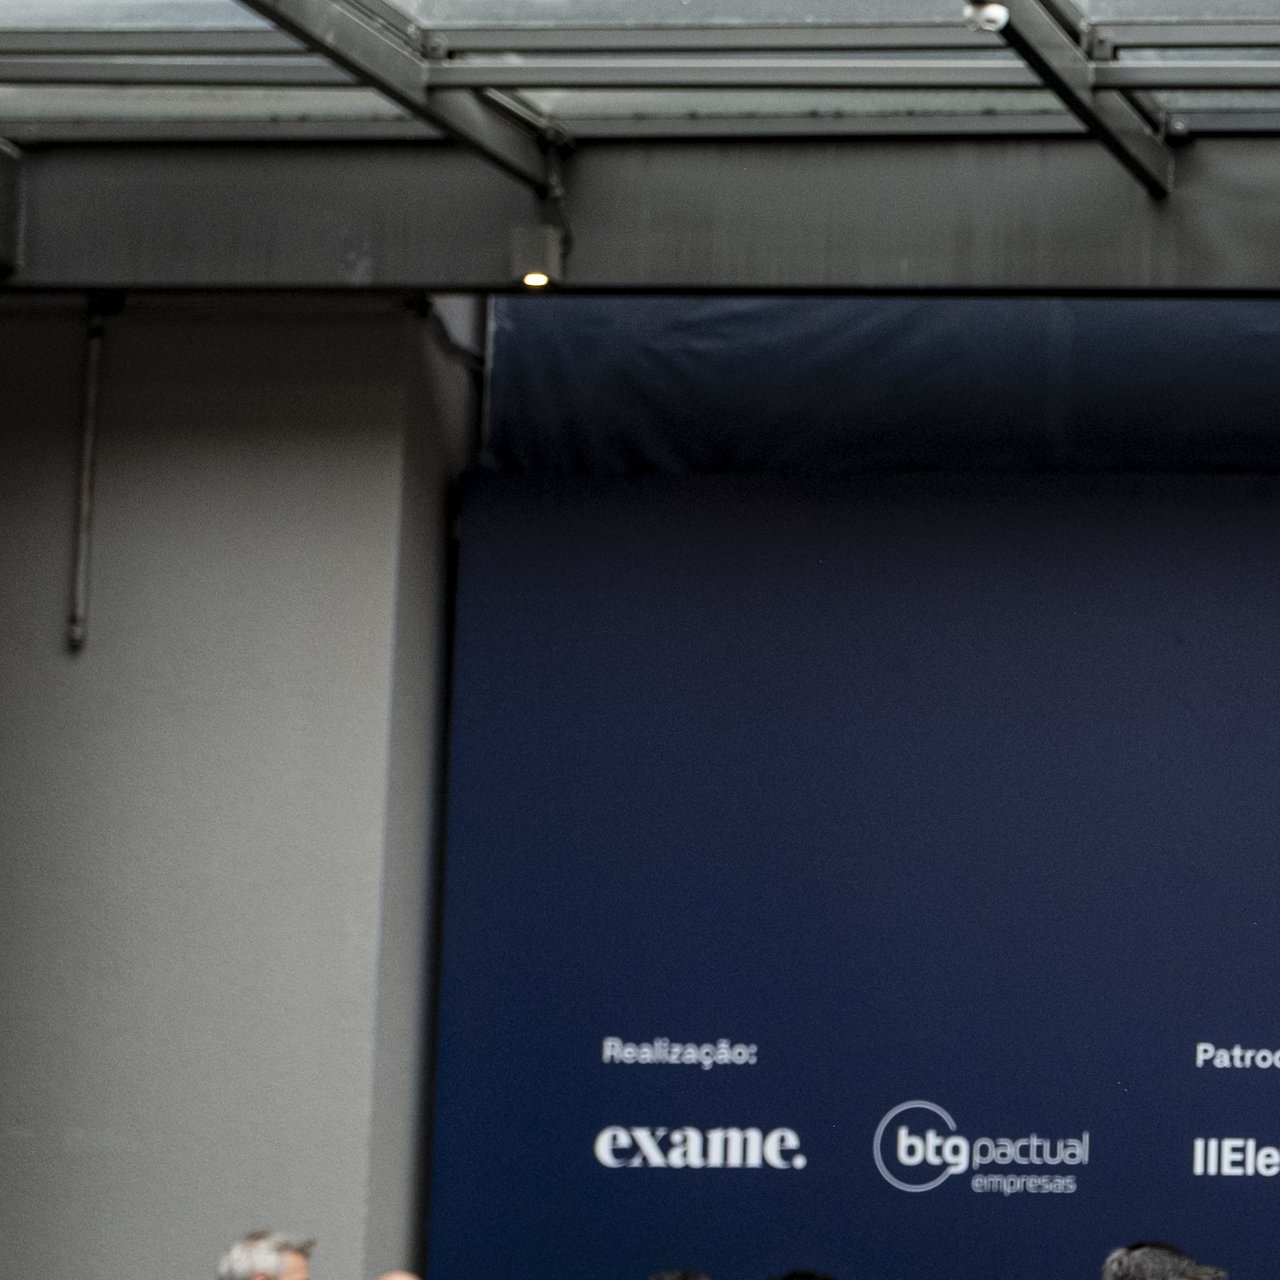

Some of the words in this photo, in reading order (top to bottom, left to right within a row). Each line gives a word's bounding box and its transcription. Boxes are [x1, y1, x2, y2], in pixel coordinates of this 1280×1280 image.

[602, 1036, 759, 1071] Realização:
[595, 1126, 807, 1170] exame.
[971, 1172, 1077, 1196] empresas
